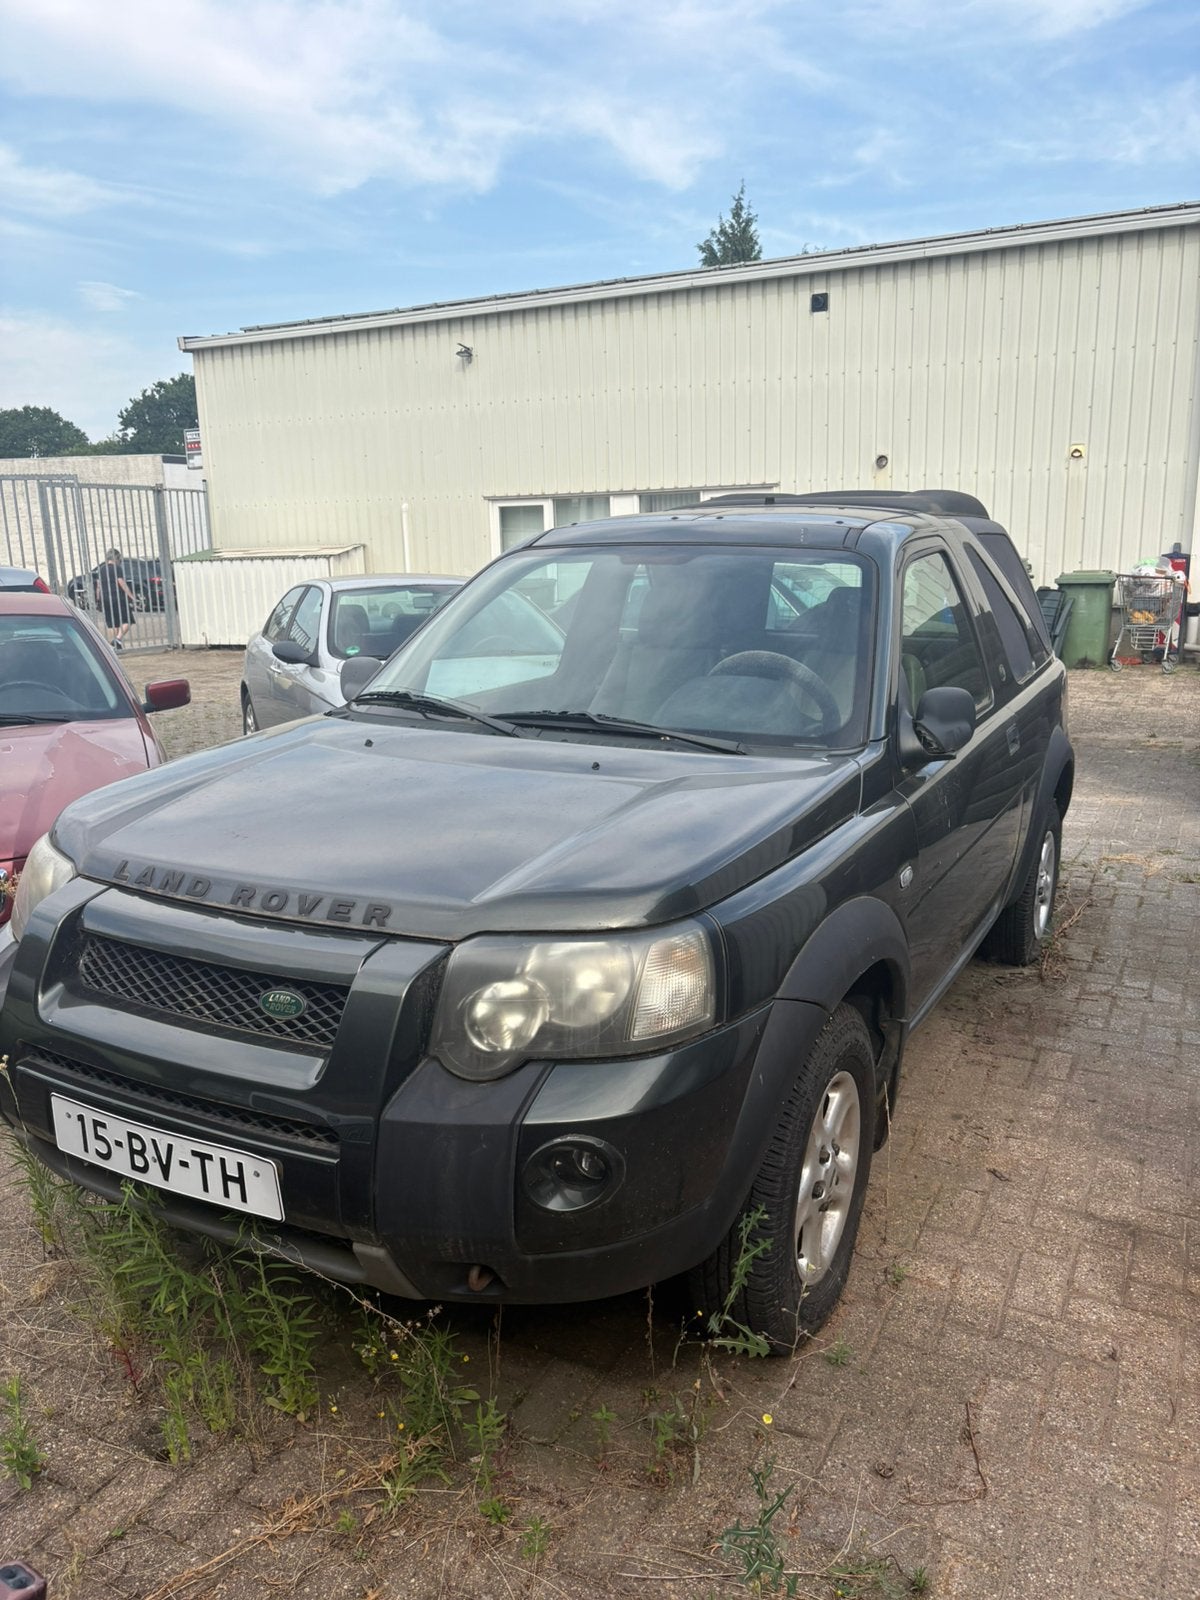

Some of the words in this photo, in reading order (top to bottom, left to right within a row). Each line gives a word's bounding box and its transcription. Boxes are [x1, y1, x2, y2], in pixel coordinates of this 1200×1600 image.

[113, 860, 212, 898] LAND
[230, 885, 393, 928] ROVER
[269, 994, 291, 1004] LAND
[269, 1002, 297, 1014] ROVER
[77, 1113, 248, 1204] 15-BV-TH
